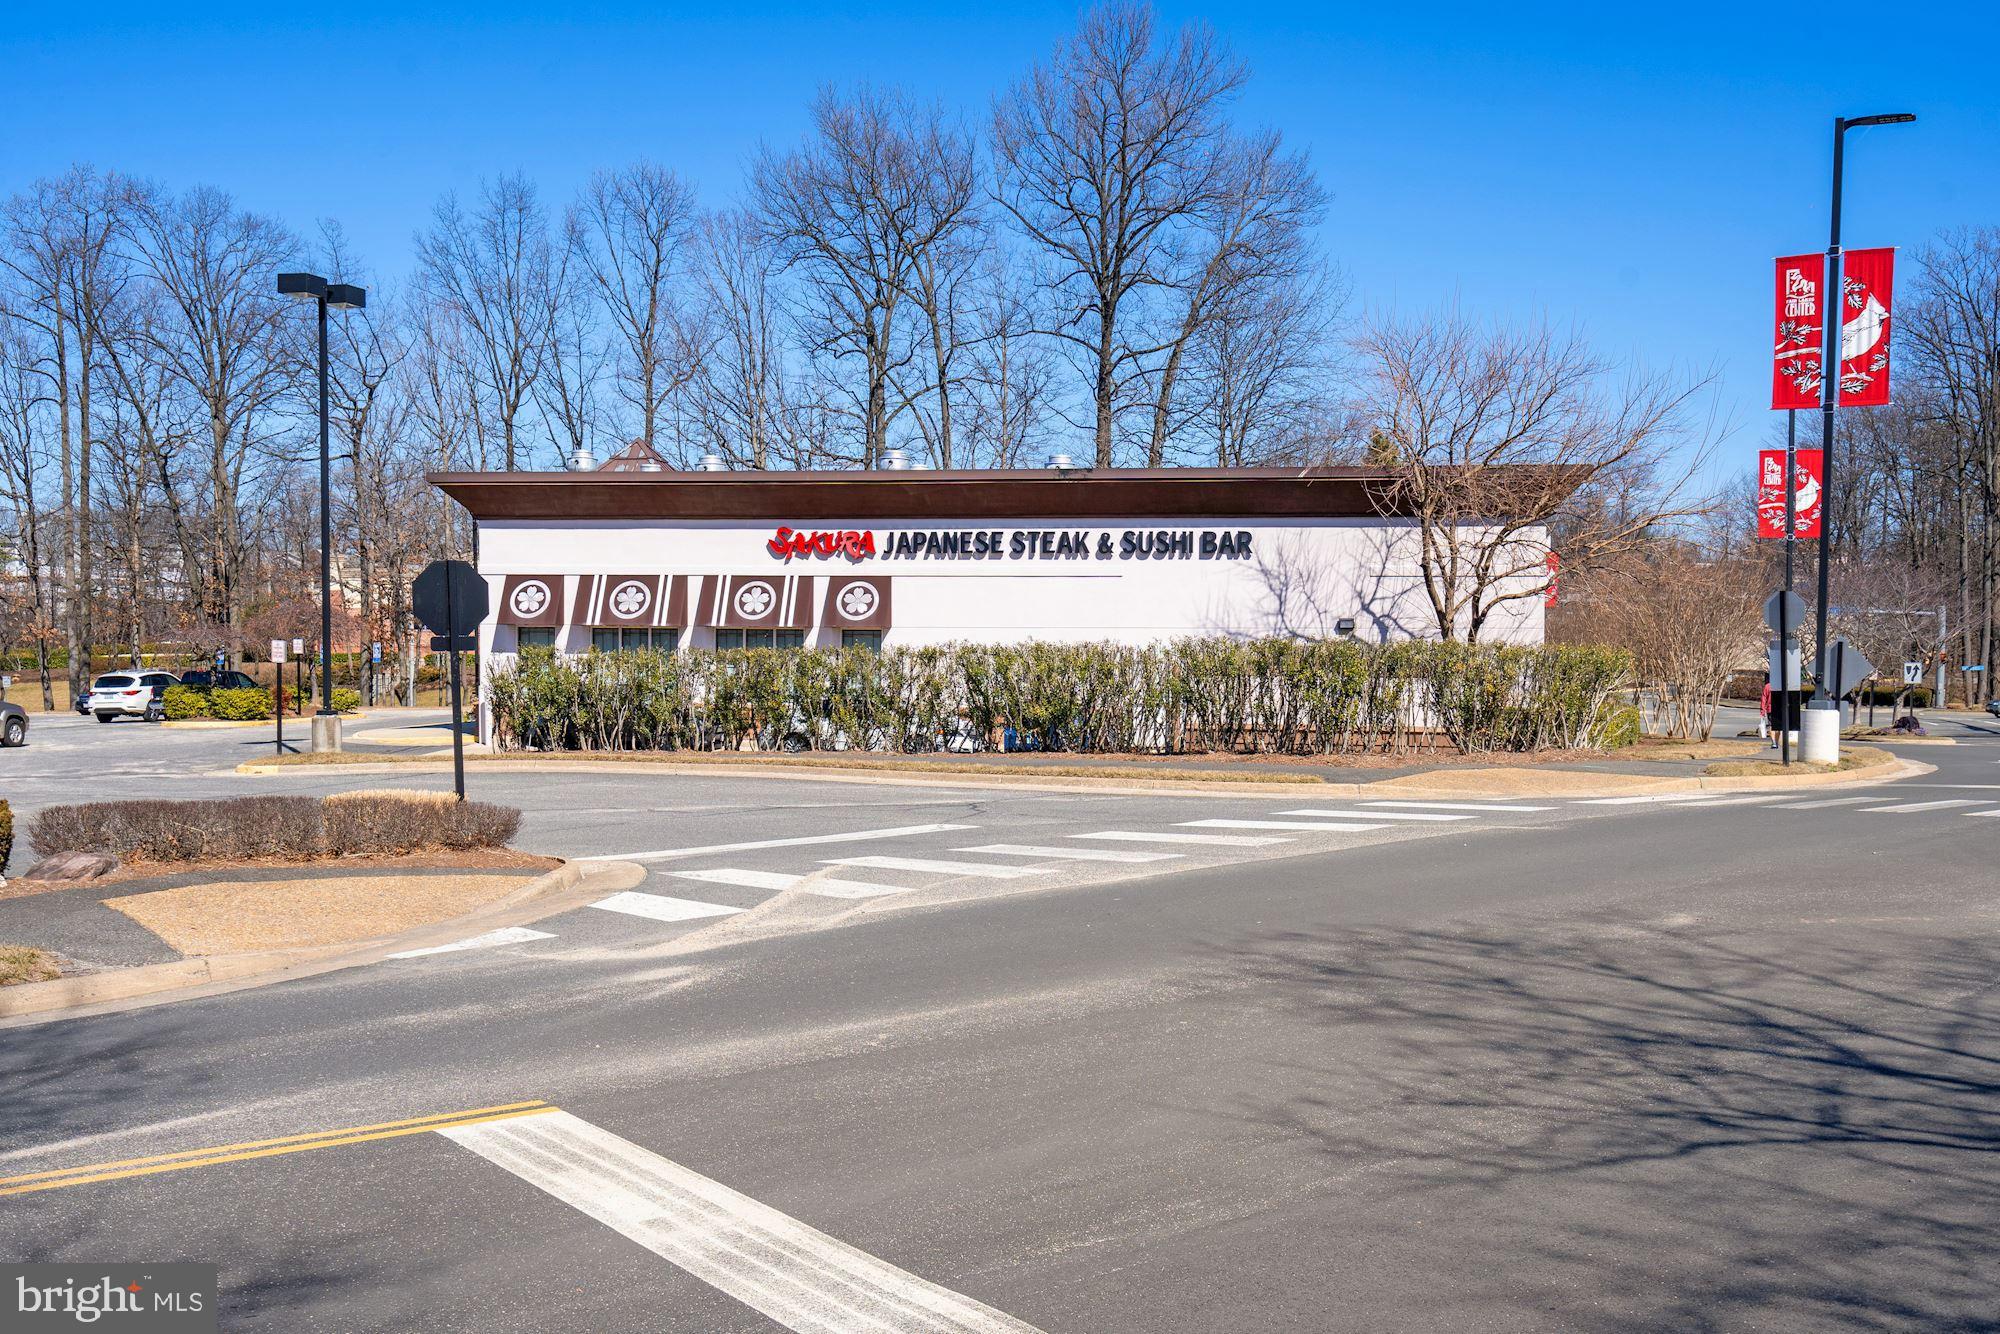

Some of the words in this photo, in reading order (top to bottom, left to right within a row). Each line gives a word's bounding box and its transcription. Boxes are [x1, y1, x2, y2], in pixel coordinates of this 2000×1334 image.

[1785, 302, 1816, 318] CENTER
[767, 527, 877, 562] SAKURA
[883, 531, 1004, 555] JAPANESE
[1011, 531, 1090, 555] STEAK
[1098, 532, 1115, 555] &
[1121, 530, 1194, 555] SUSHI
[1202, 531, 1253, 555] BAR
